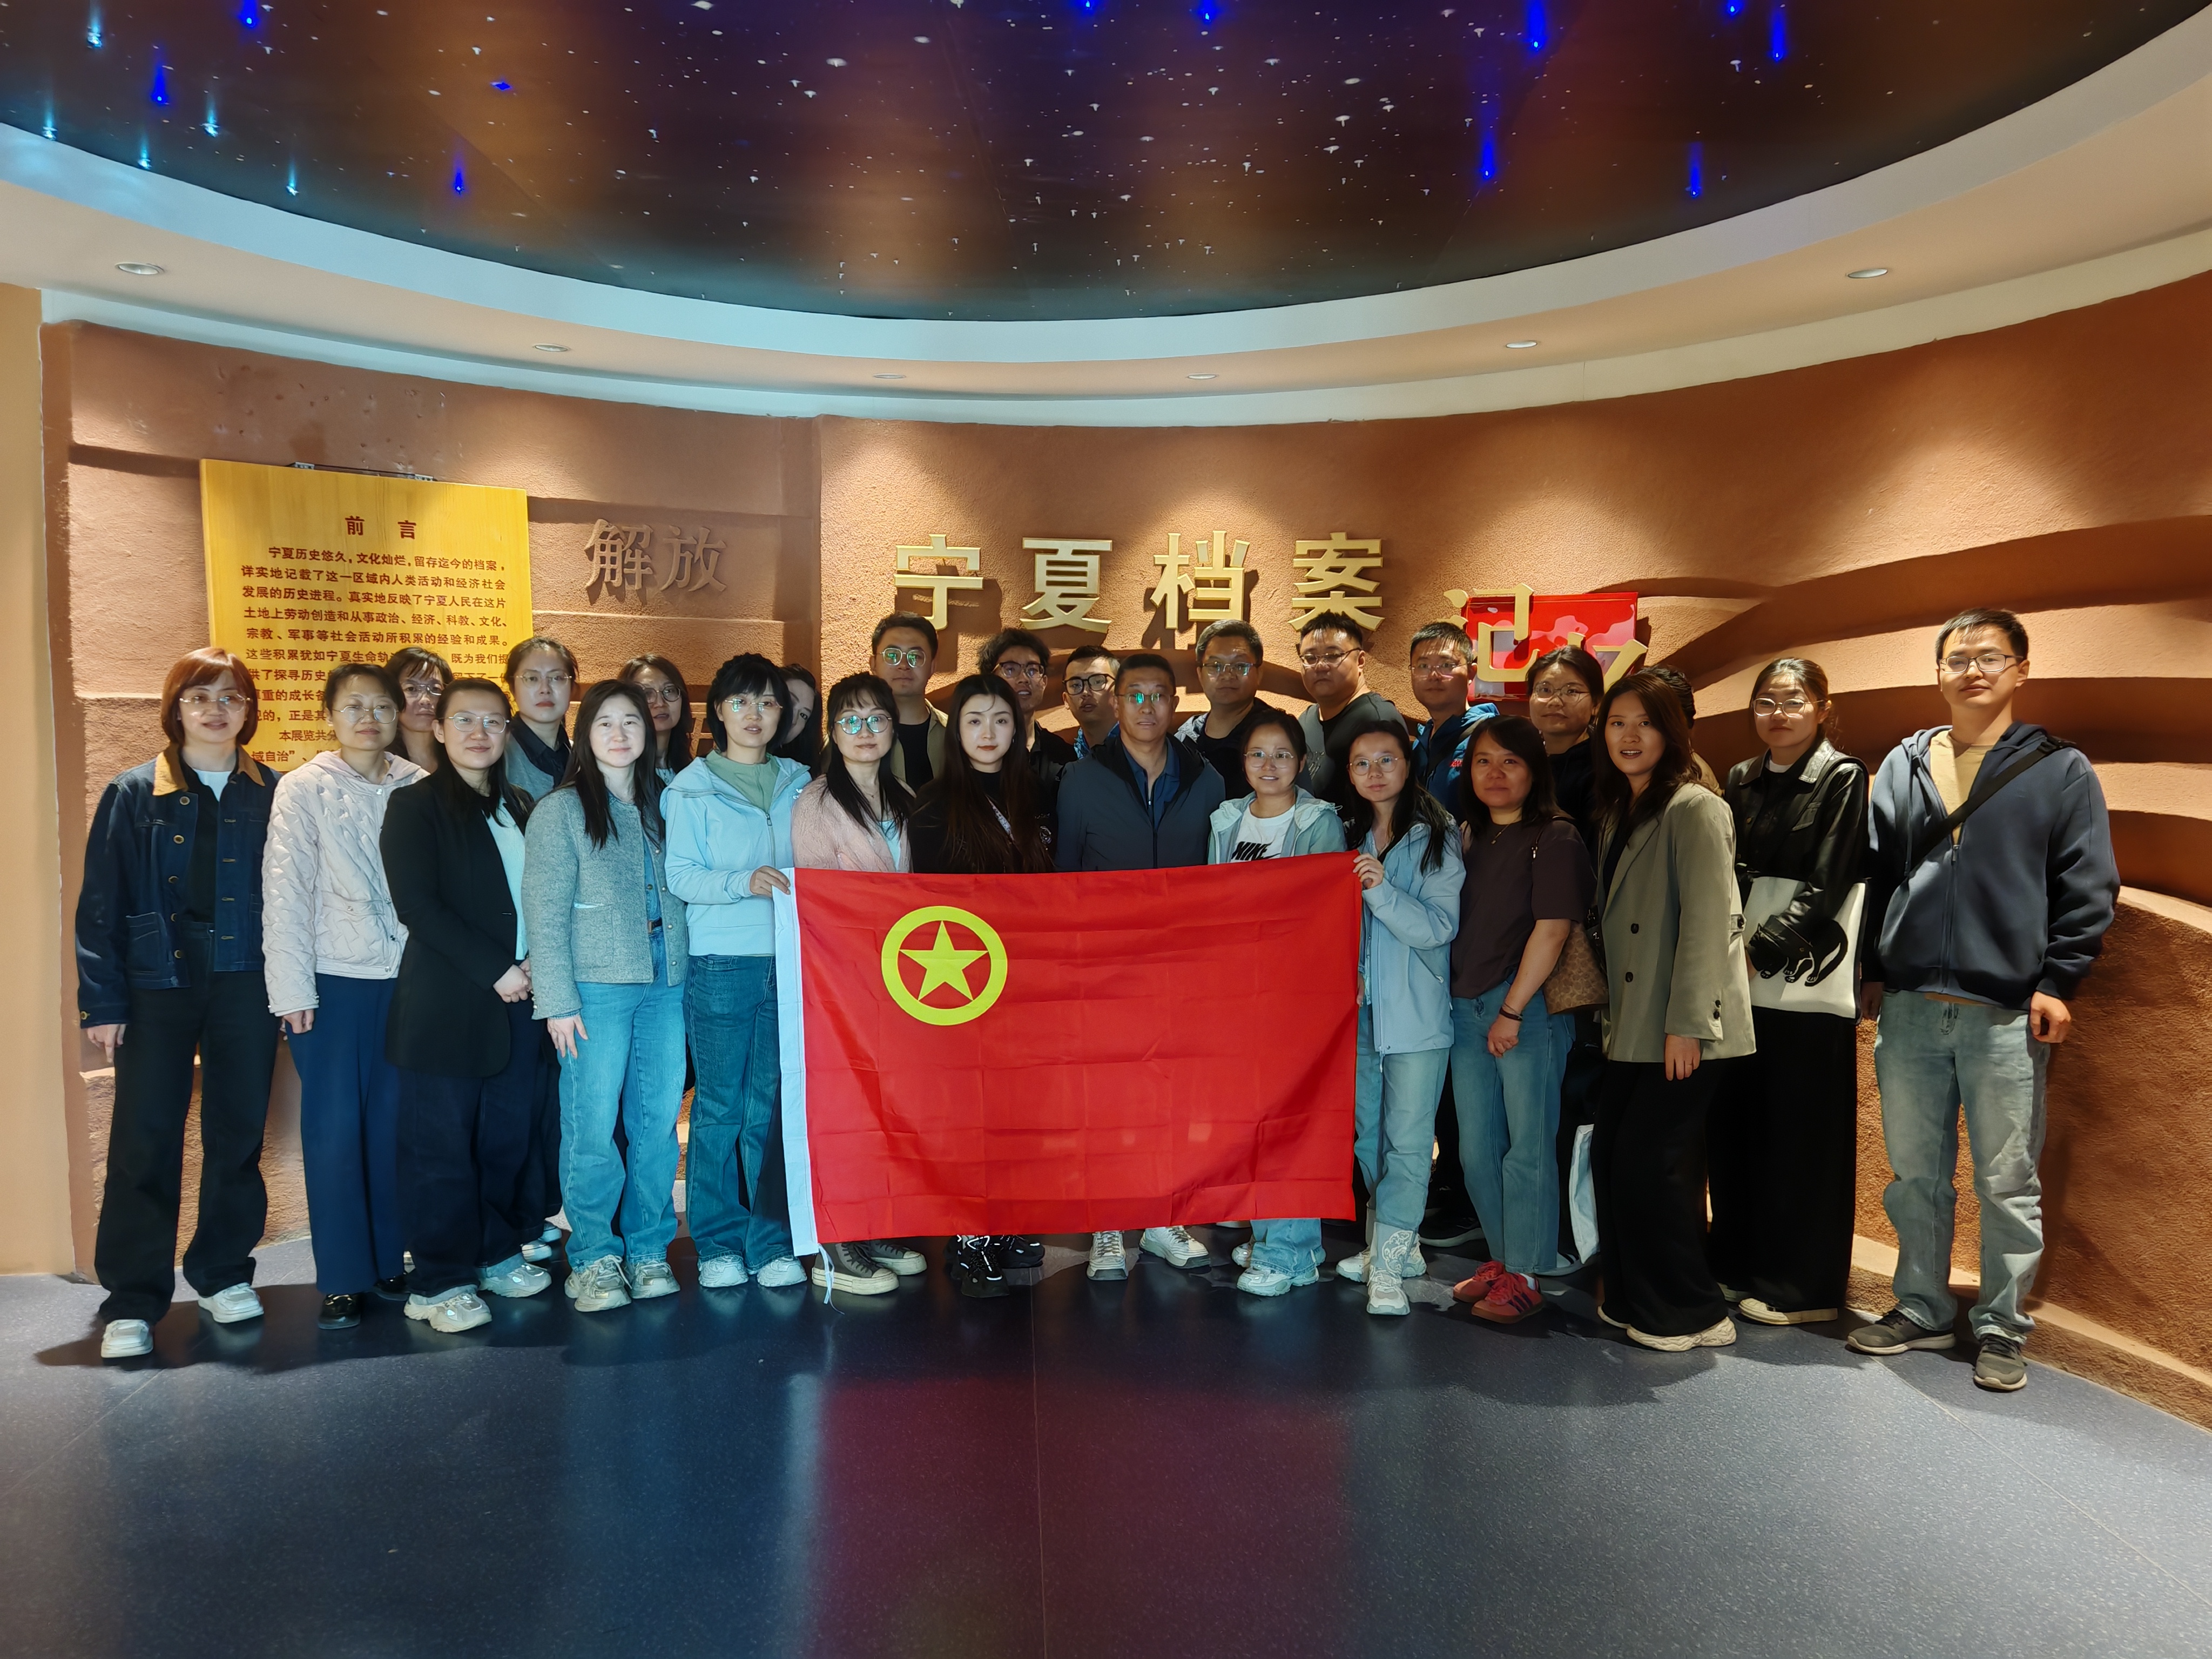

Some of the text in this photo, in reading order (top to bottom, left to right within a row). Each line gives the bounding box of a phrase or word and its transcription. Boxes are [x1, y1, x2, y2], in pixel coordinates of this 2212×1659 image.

[585, 518, 727, 592] 解放
[241, 565, 506, 590] 详实地记载了这一区域内人类活动和经济社会
[242, 585, 506, 609] 发展的历史进程。真实地反映了宁夏人民在这片
[244, 606, 507, 628] 土地上劳动创造和从事政治、经济、科教、文化、
[246, 628, 508, 647] 宗教、军事等社会活动所积累的经验和成果。
